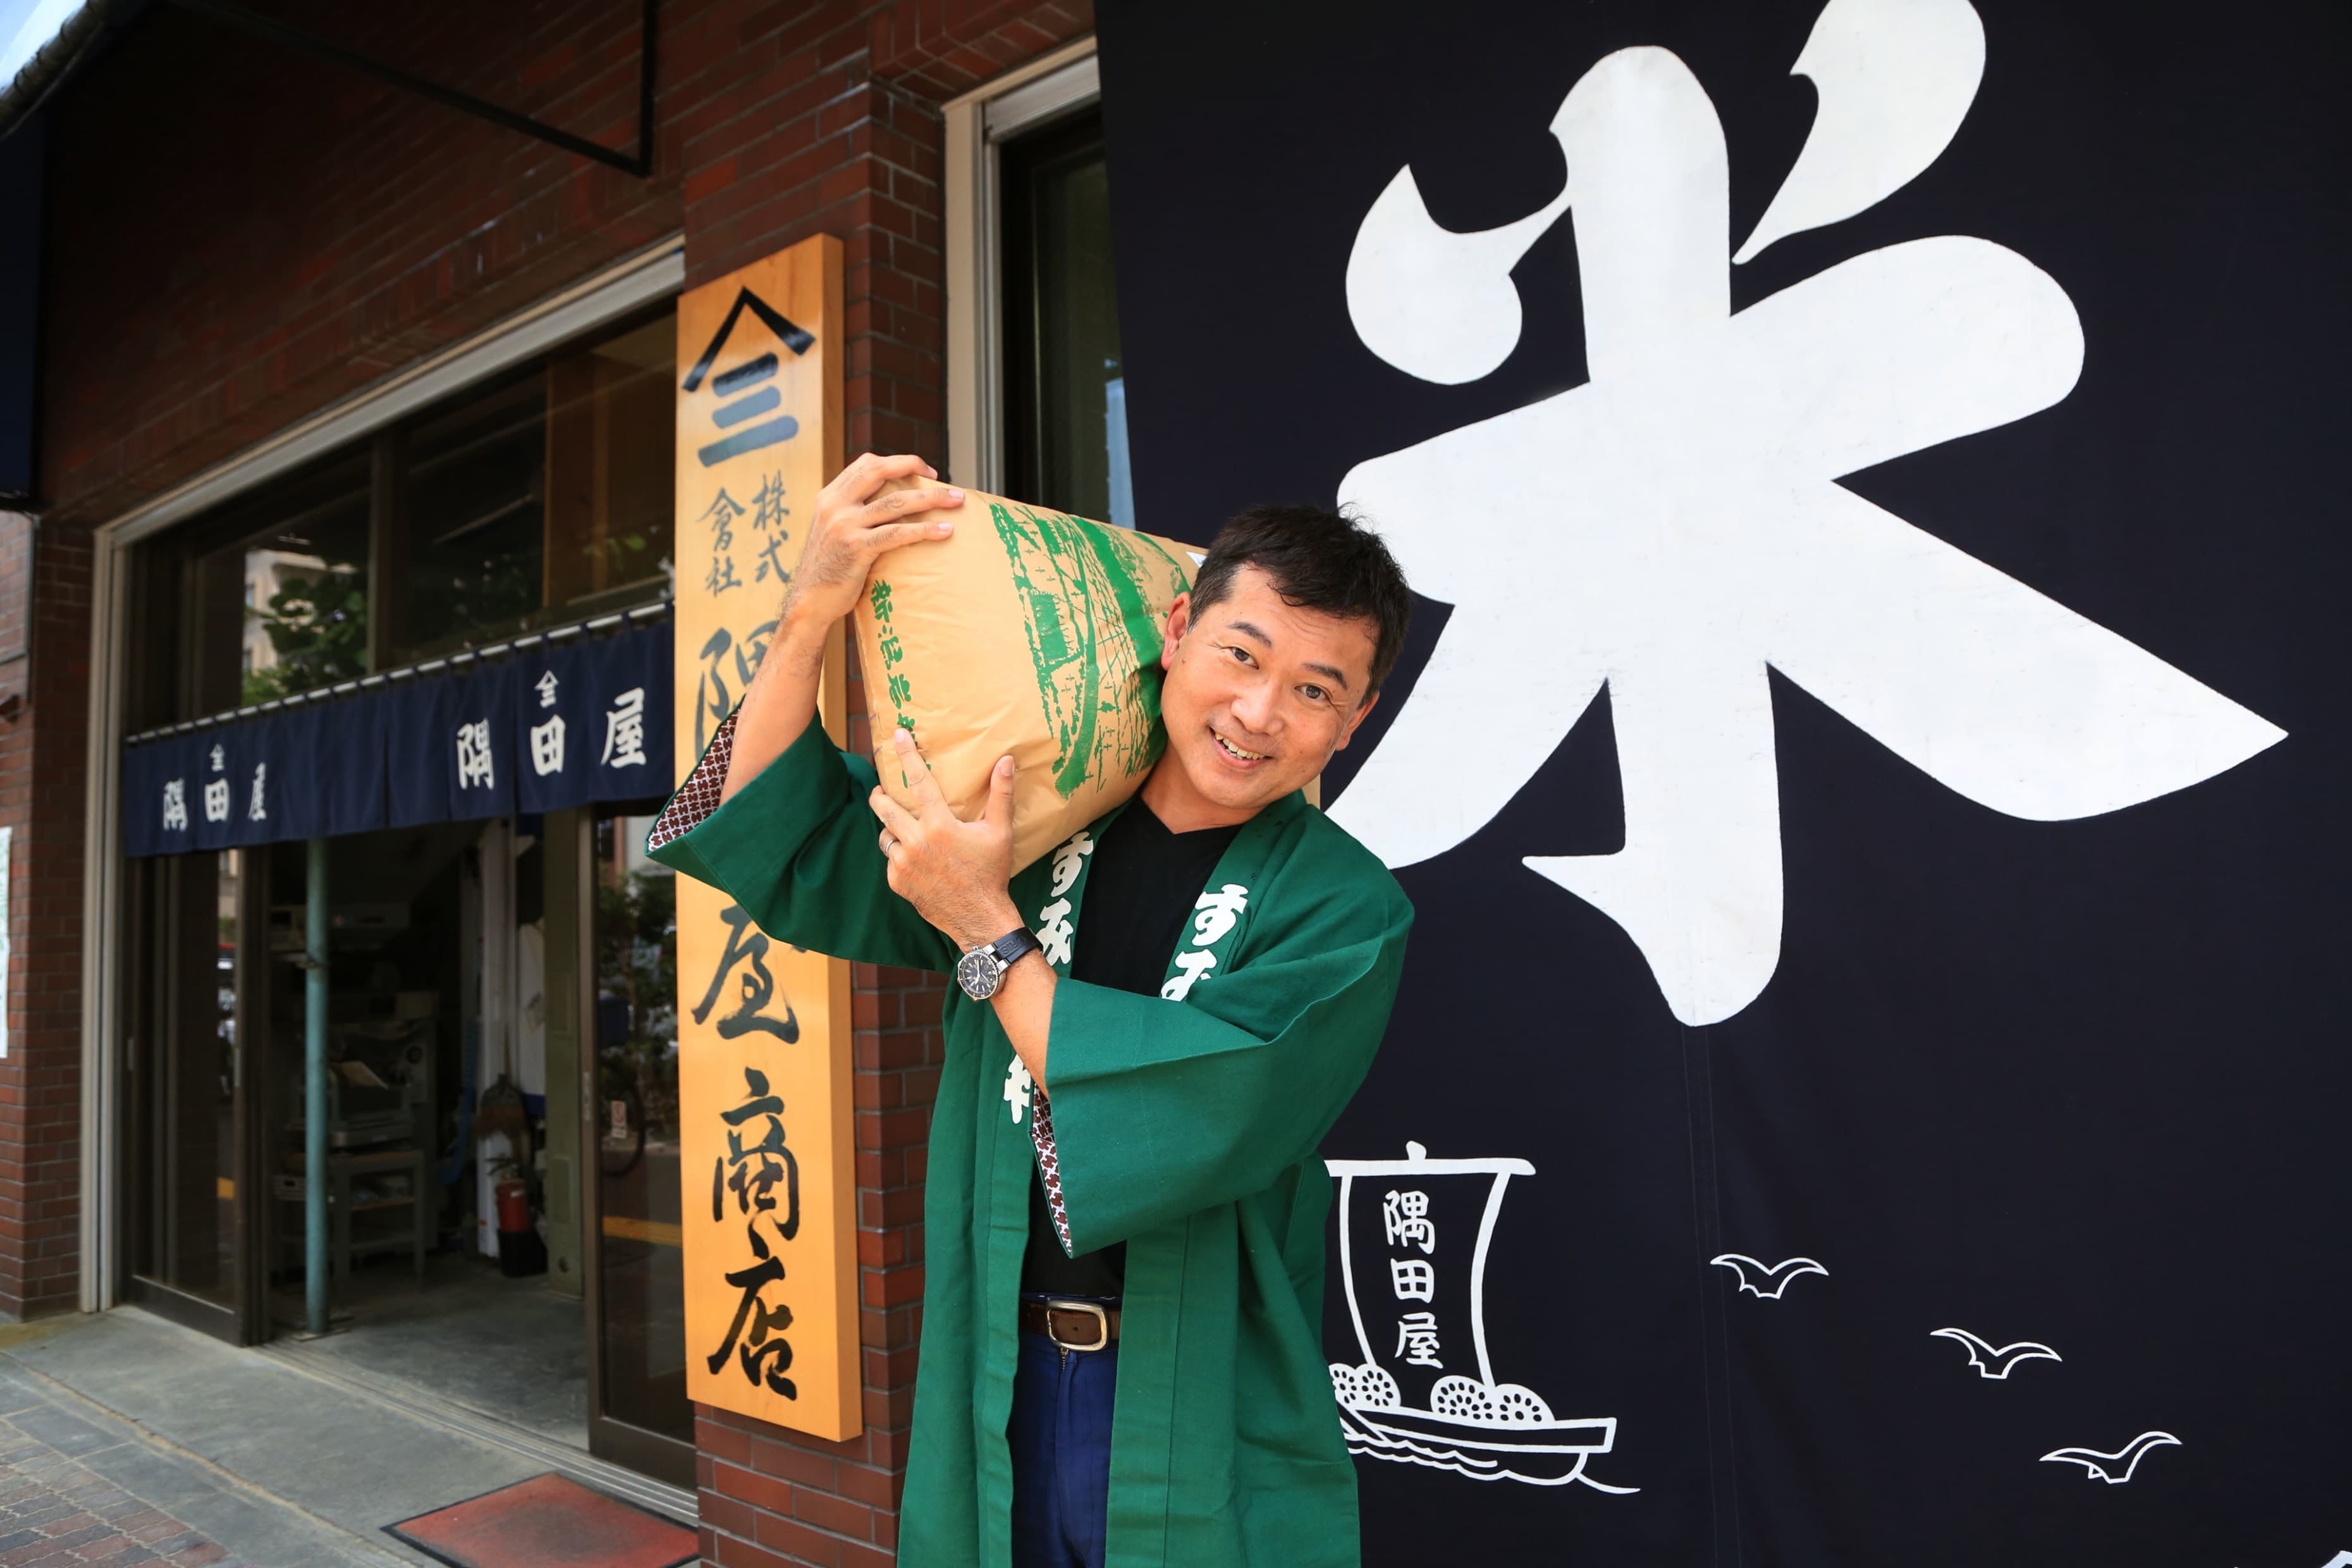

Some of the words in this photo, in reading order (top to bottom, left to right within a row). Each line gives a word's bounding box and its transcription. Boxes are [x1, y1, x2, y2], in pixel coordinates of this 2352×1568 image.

[696, 487, 745, 597] 會社
[752, 469, 790, 584] 株式
[1325, 0, 2288, 1027] 米
[456, 687, 646, 790] 隅田屋
[870, 579, 931, 789] 新潟岩
[1383, 1189, 1443, 1369] 隅田屋
